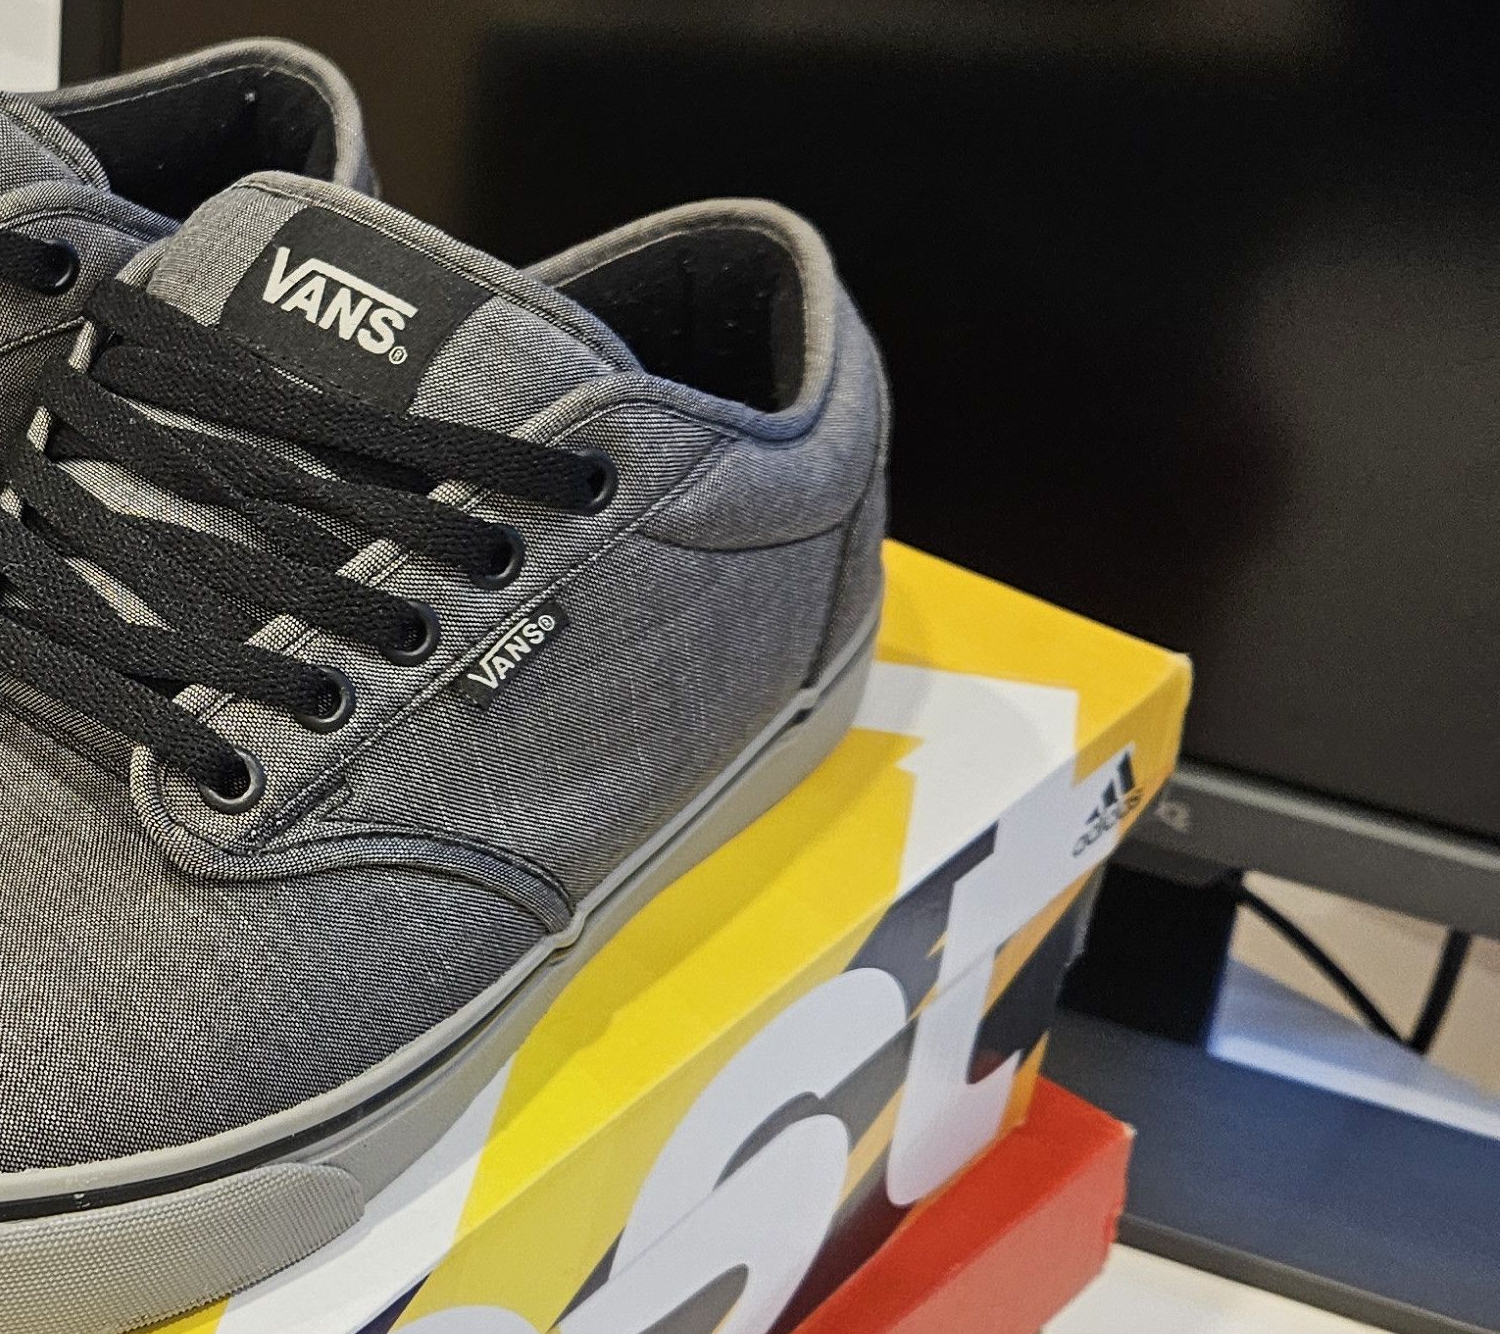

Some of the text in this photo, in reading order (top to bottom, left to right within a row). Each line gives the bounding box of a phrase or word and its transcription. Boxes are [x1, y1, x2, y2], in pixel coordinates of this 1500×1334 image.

[263, 246, 419, 355] VANS
[466, 617, 546, 689] VANS
[1072, 787, 1143, 857] adidas
